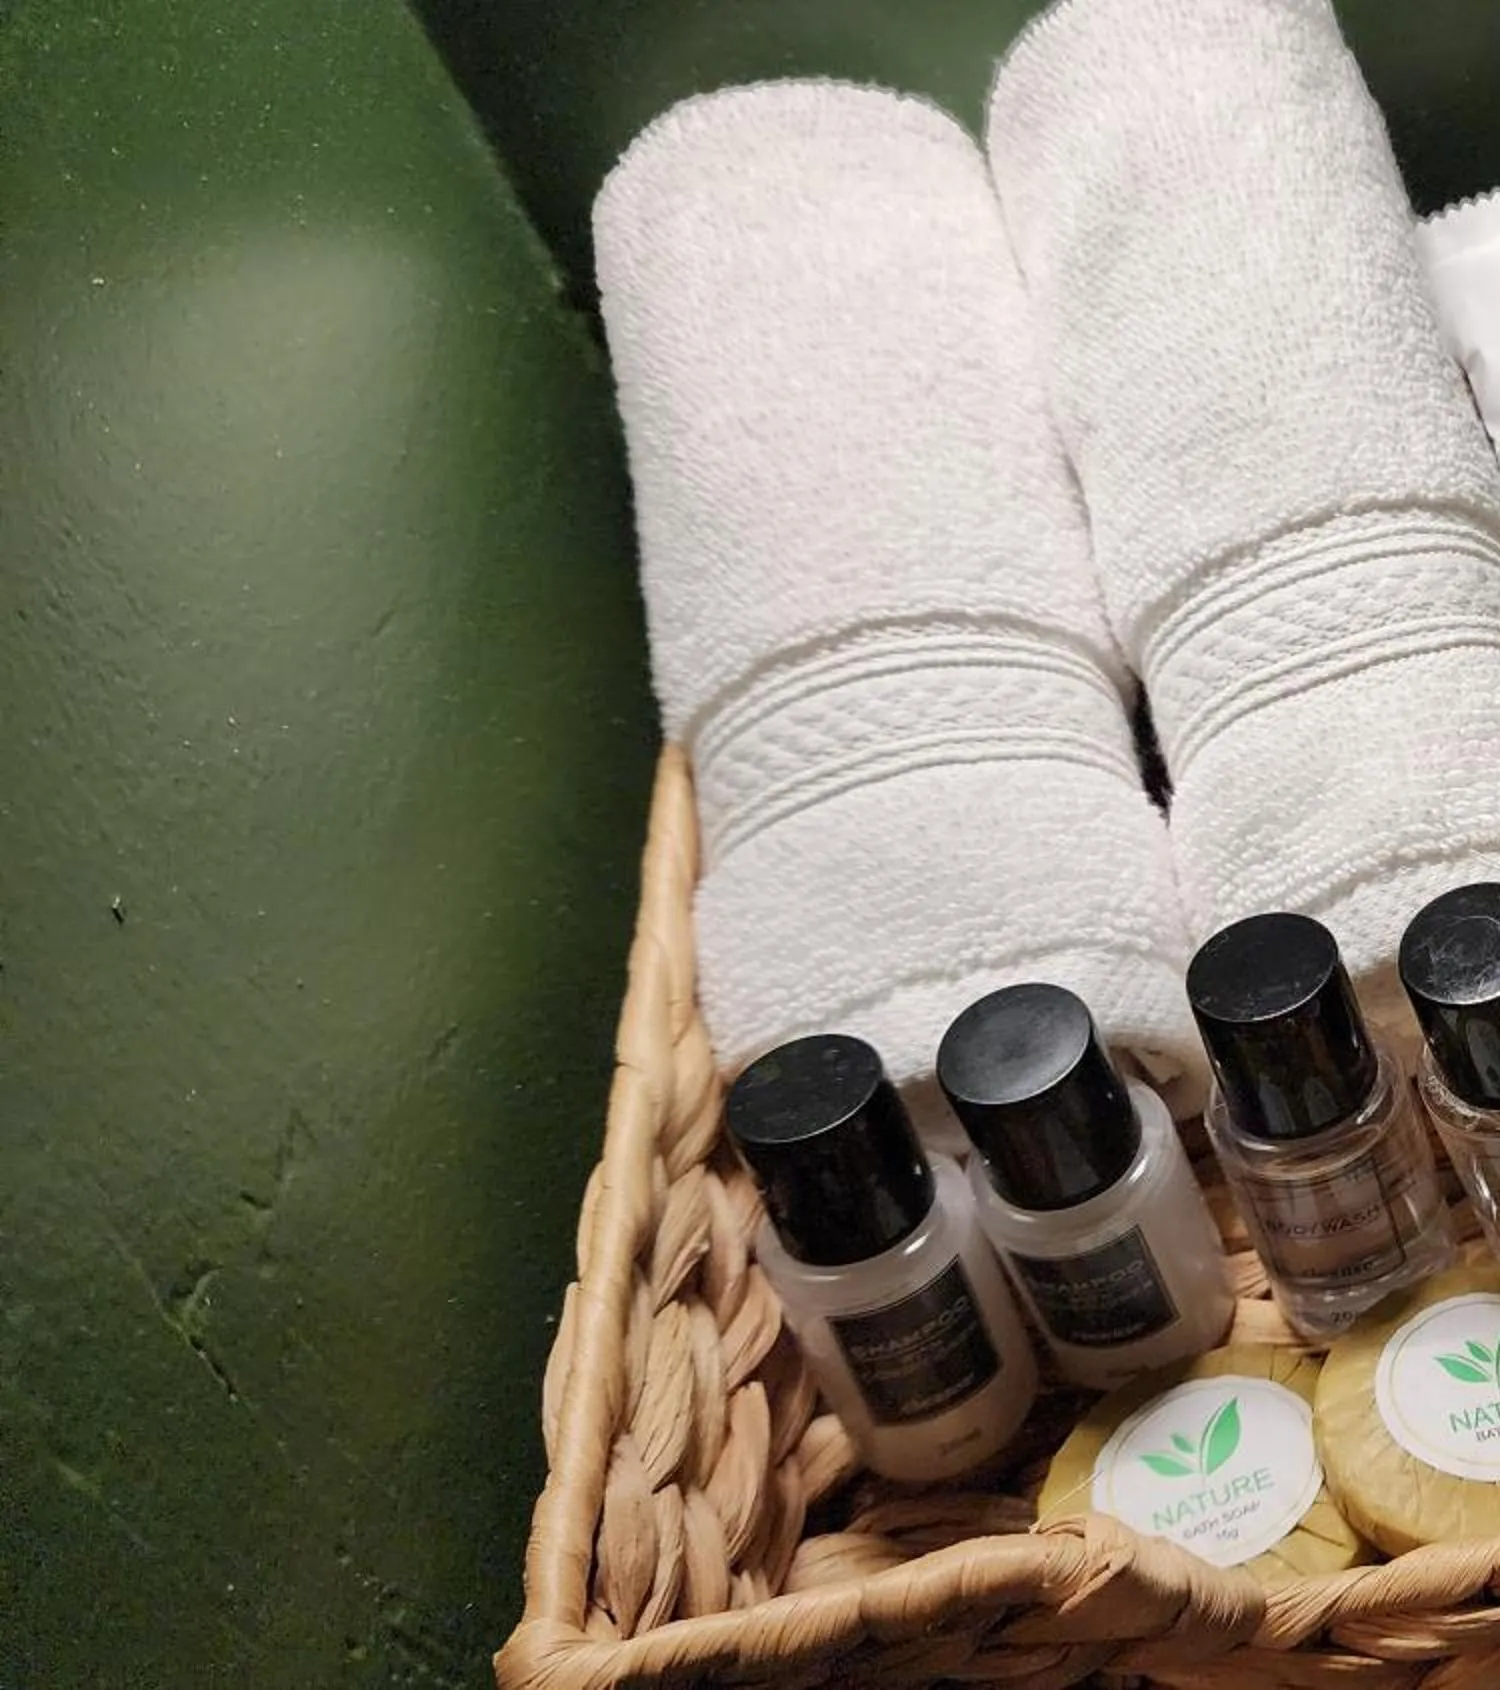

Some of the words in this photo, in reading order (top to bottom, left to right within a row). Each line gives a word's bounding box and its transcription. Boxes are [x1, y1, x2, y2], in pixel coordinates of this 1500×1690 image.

[1152, 1467, 1276, 1531] NATURE
[1183, 1517, 1219, 1539] BATH
[1221, 1500, 1261, 1523] SOAP
